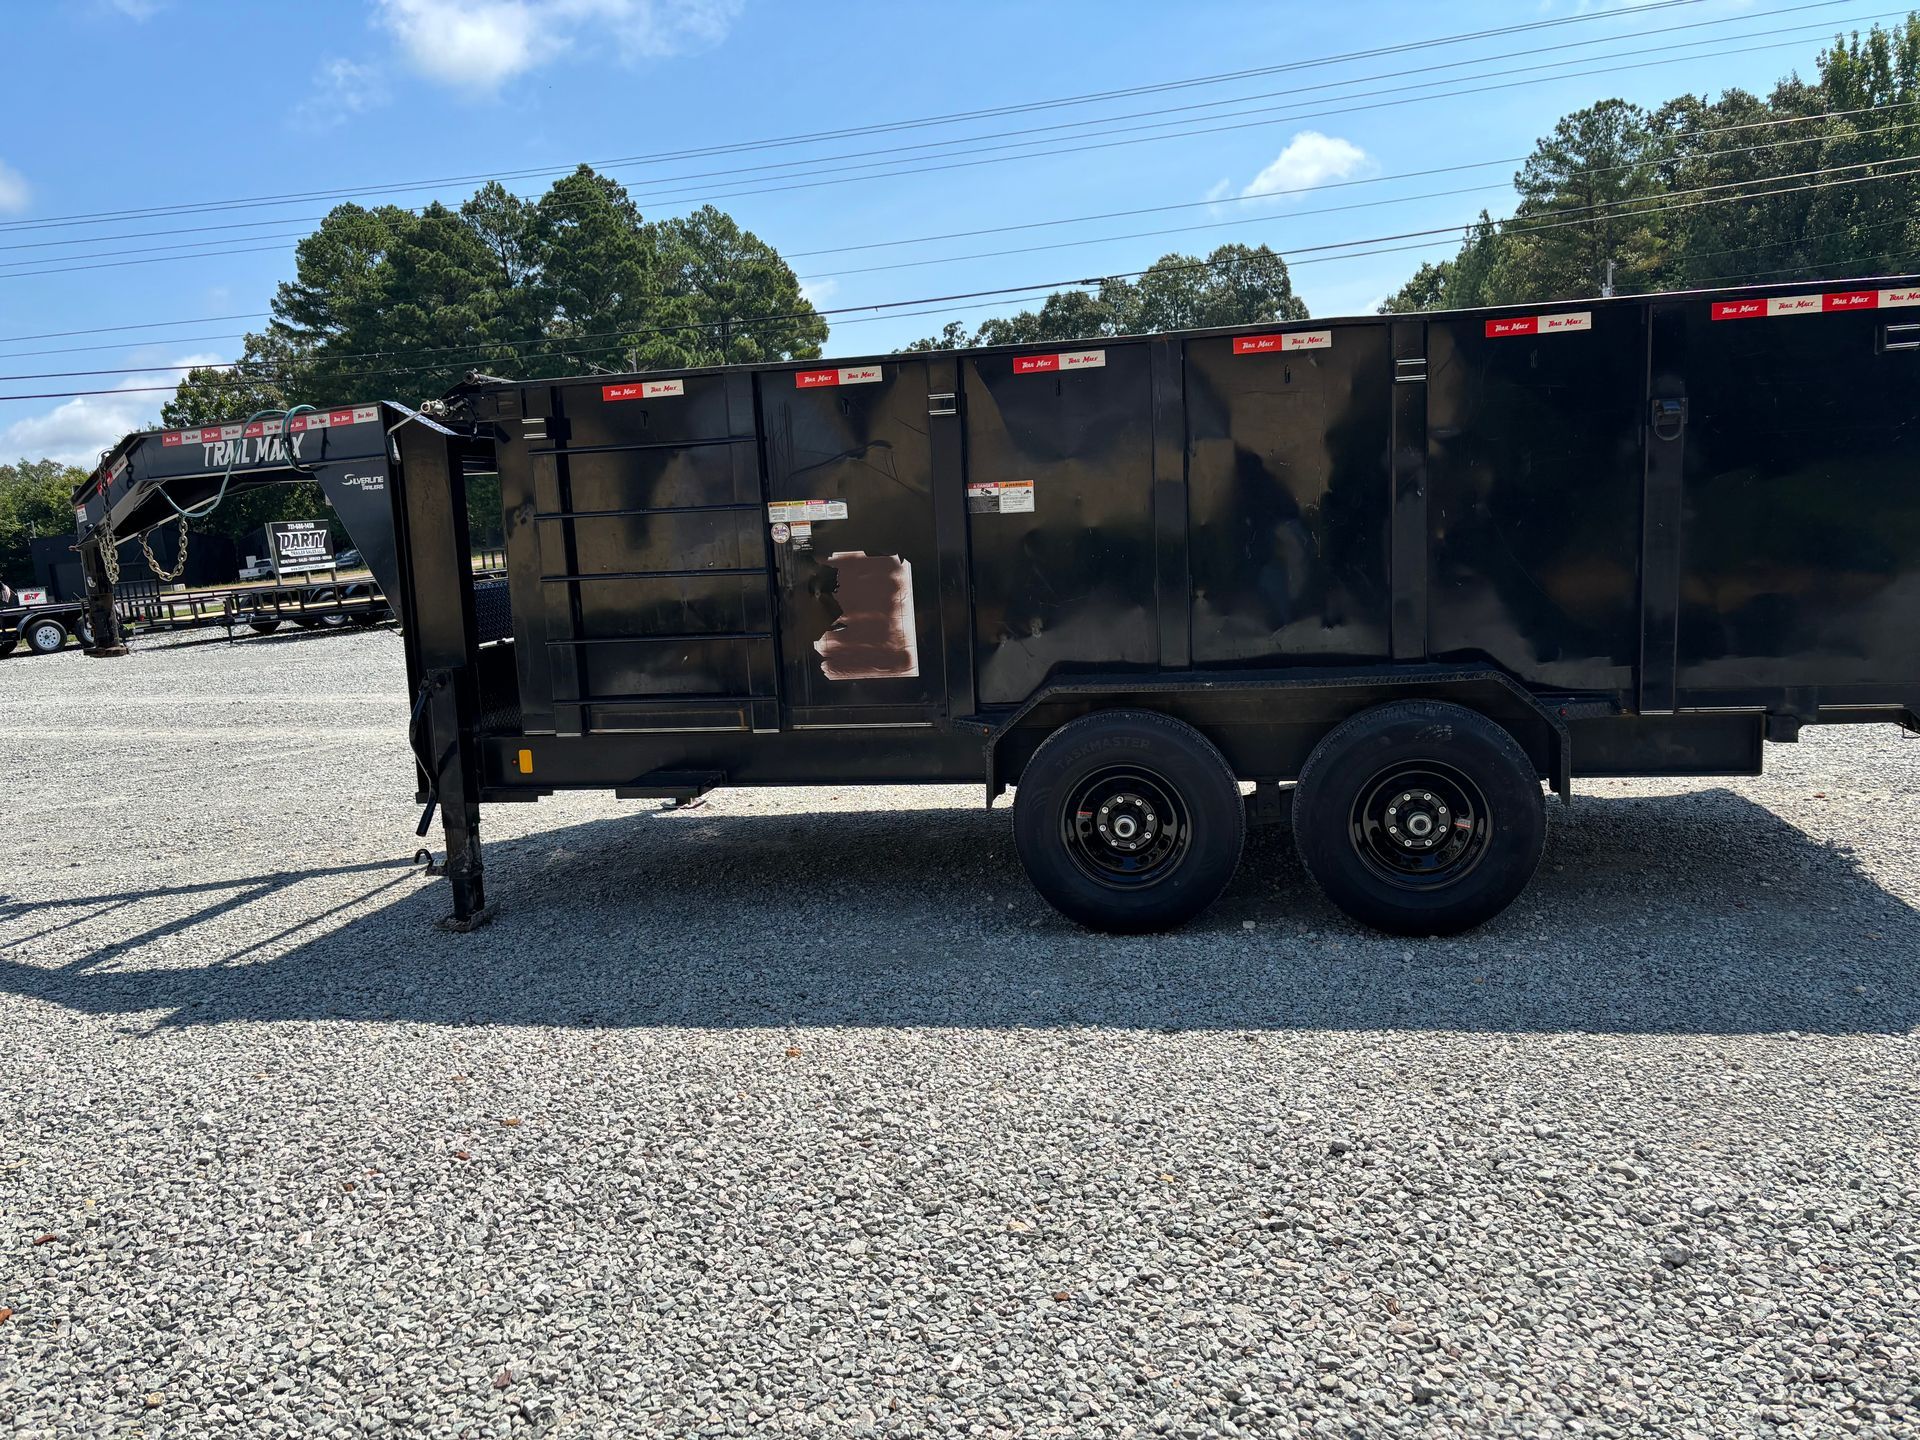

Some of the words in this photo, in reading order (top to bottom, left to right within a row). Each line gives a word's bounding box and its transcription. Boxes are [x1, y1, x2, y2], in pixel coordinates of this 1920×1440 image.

[202, 439, 250, 467] TRAIL
[342, 474, 384, 485] SILVERLINE
[277, 530, 327, 550] DARTY
[1056, 736, 1151, 769] TASKMASTER
